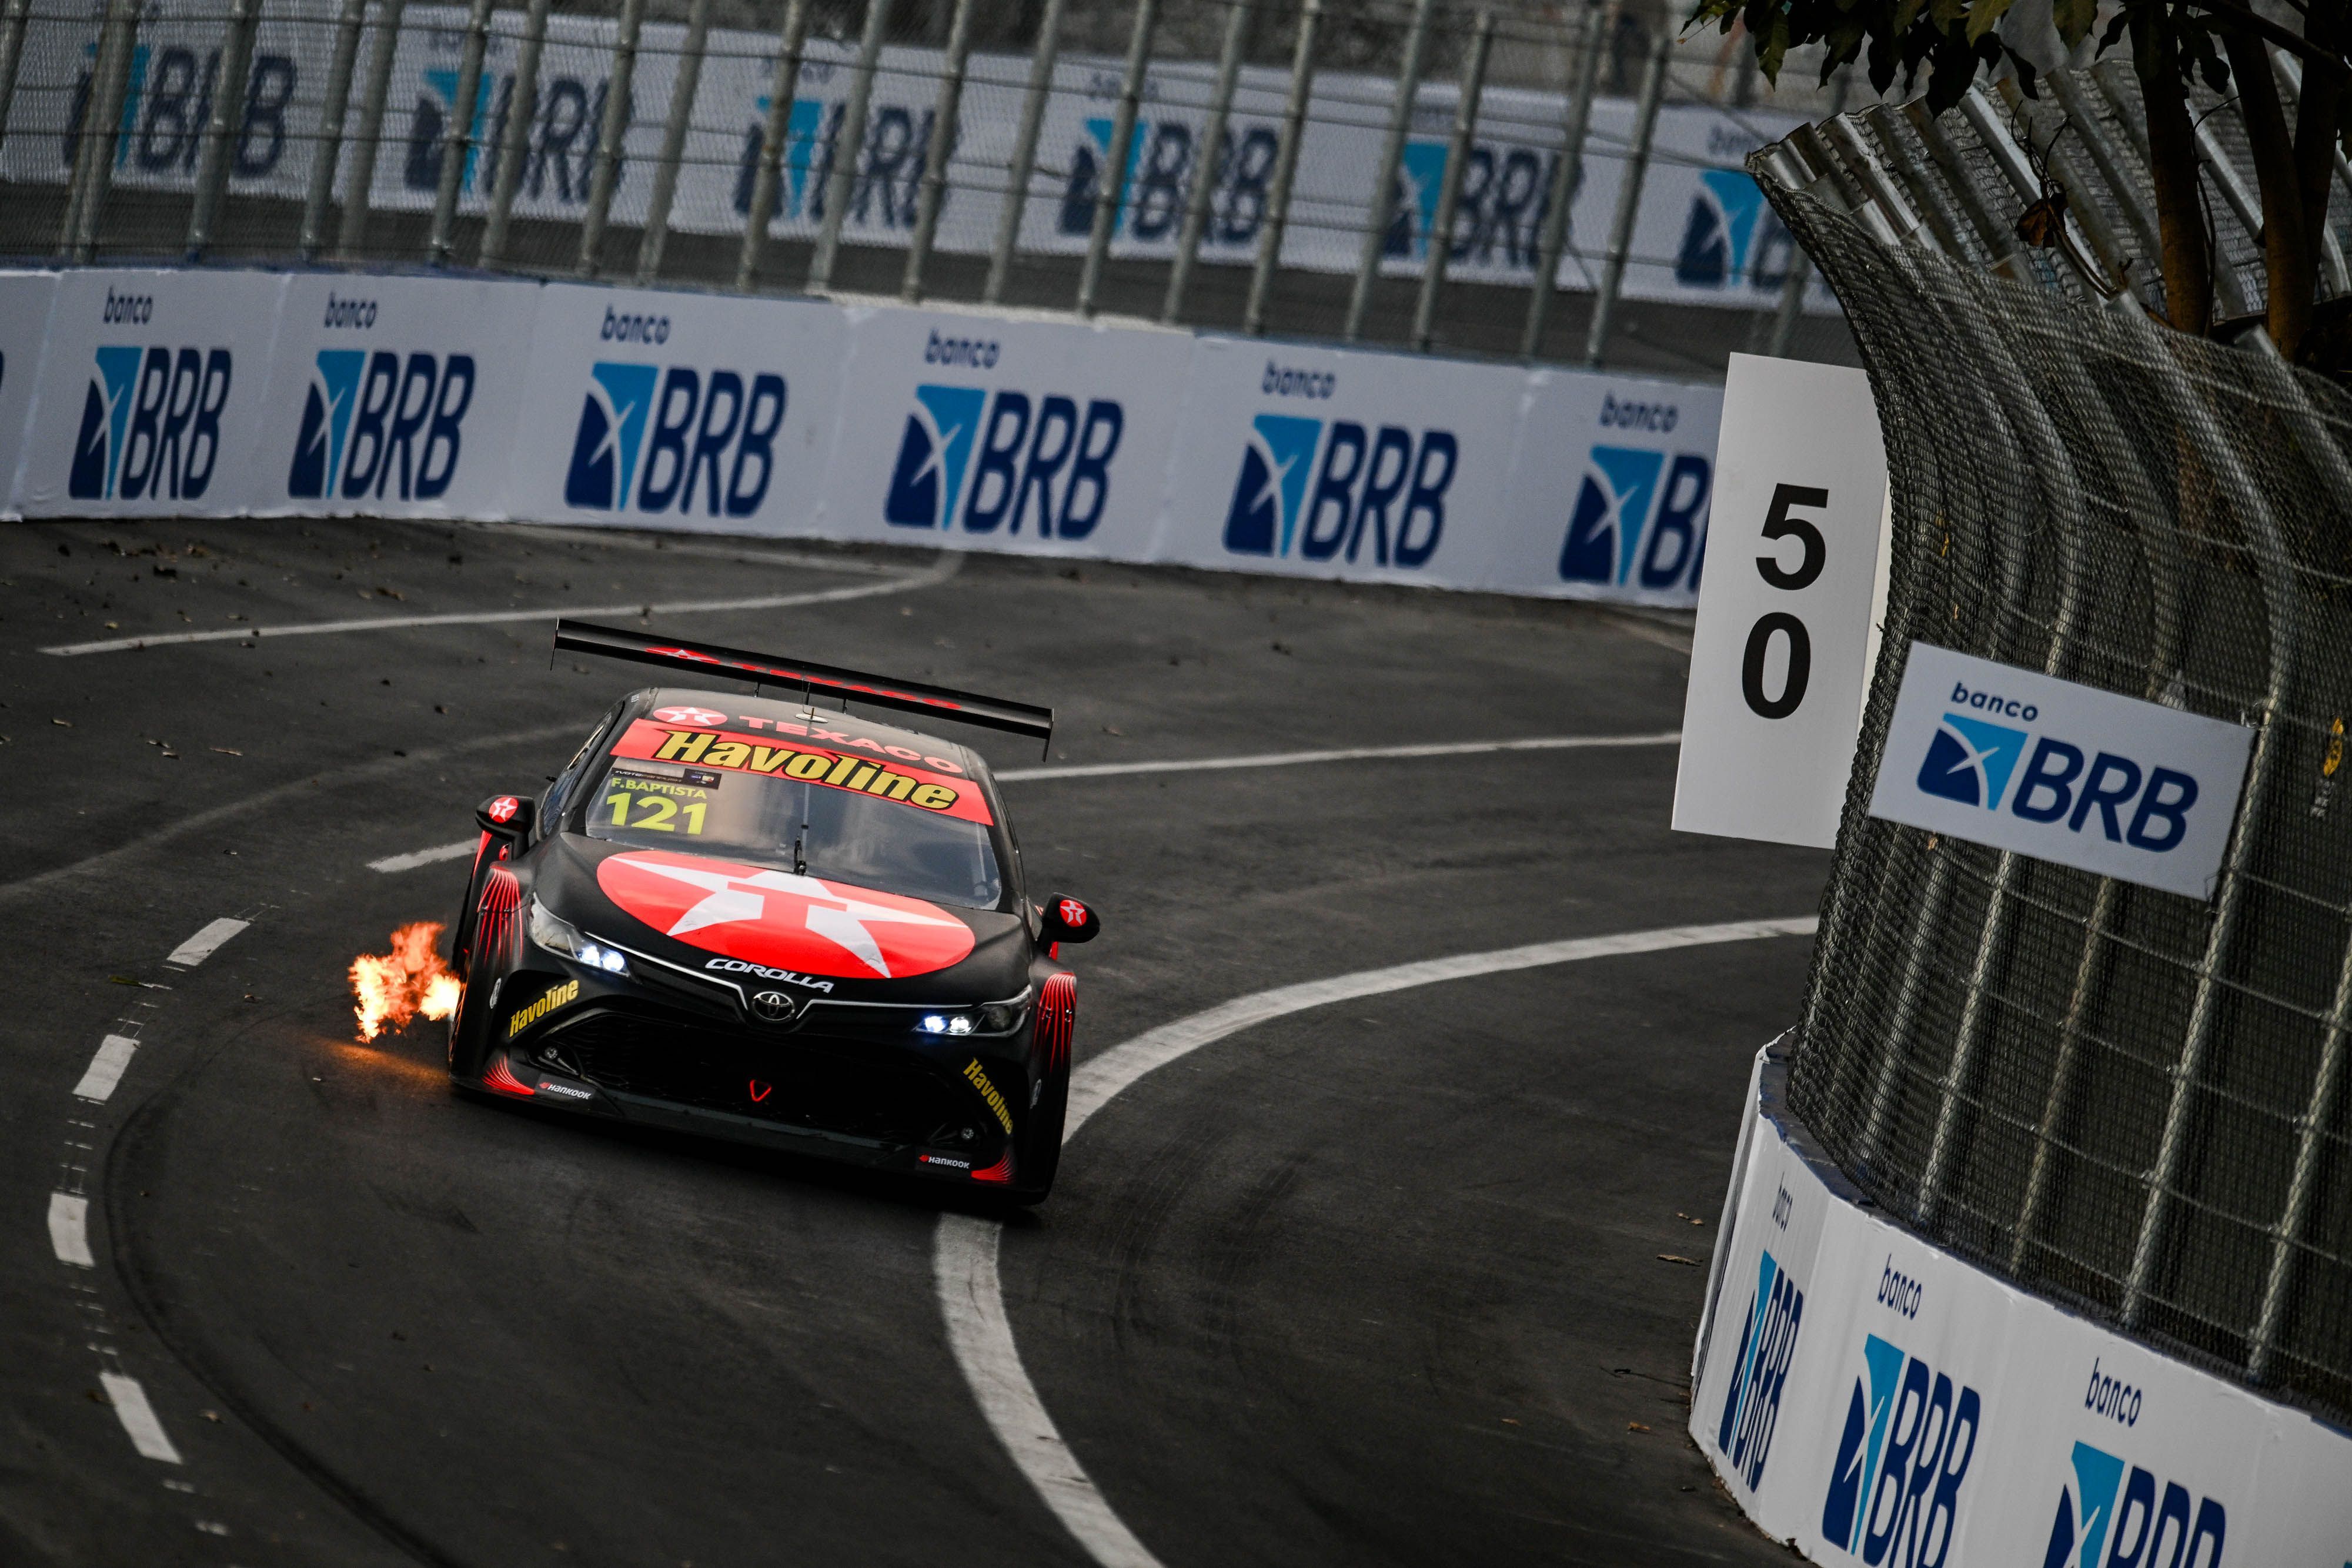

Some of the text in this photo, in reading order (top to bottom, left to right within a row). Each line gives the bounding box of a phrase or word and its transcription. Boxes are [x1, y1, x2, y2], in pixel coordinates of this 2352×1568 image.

[103, 286, 153, 325] banco
[324, 291, 378, 329] banco
[600, 303, 671, 346] banco
[924, 329, 999, 369] banco
[1261, 357, 1337, 400] banco
[119, 347, 232, 500] BRB
[342, 352, 477, 502] BRB
[637, 366, 789, 519] BRB
[1598, 392, 1679, 433] banco
[963, 389, 1125, 541] BRB
[1301, 420, 1460, 570] BRB
[1950, 680, 2039, 721] banco
[654, 730, 959, 810] Havoline
[739, 716, 963, 773] TEXACO
[606, 792, 707, 835] 121
[611, 778, 707, 800] F.BAPTISTA
[2011, 737, 2199, 853] BRB
[705, 958, 834, 994] COROLLA
[509, 979, 579, 1037] Havoline
[962, 1057, 1014, 1135] Havoline
[1877, 1253, 1922, 1320] banco
[1732, 1267, 1803, 1493] BRB
[2084, 1356, 2143, 1427] banco
[1862, 1357, 1980, 1568] BRB
